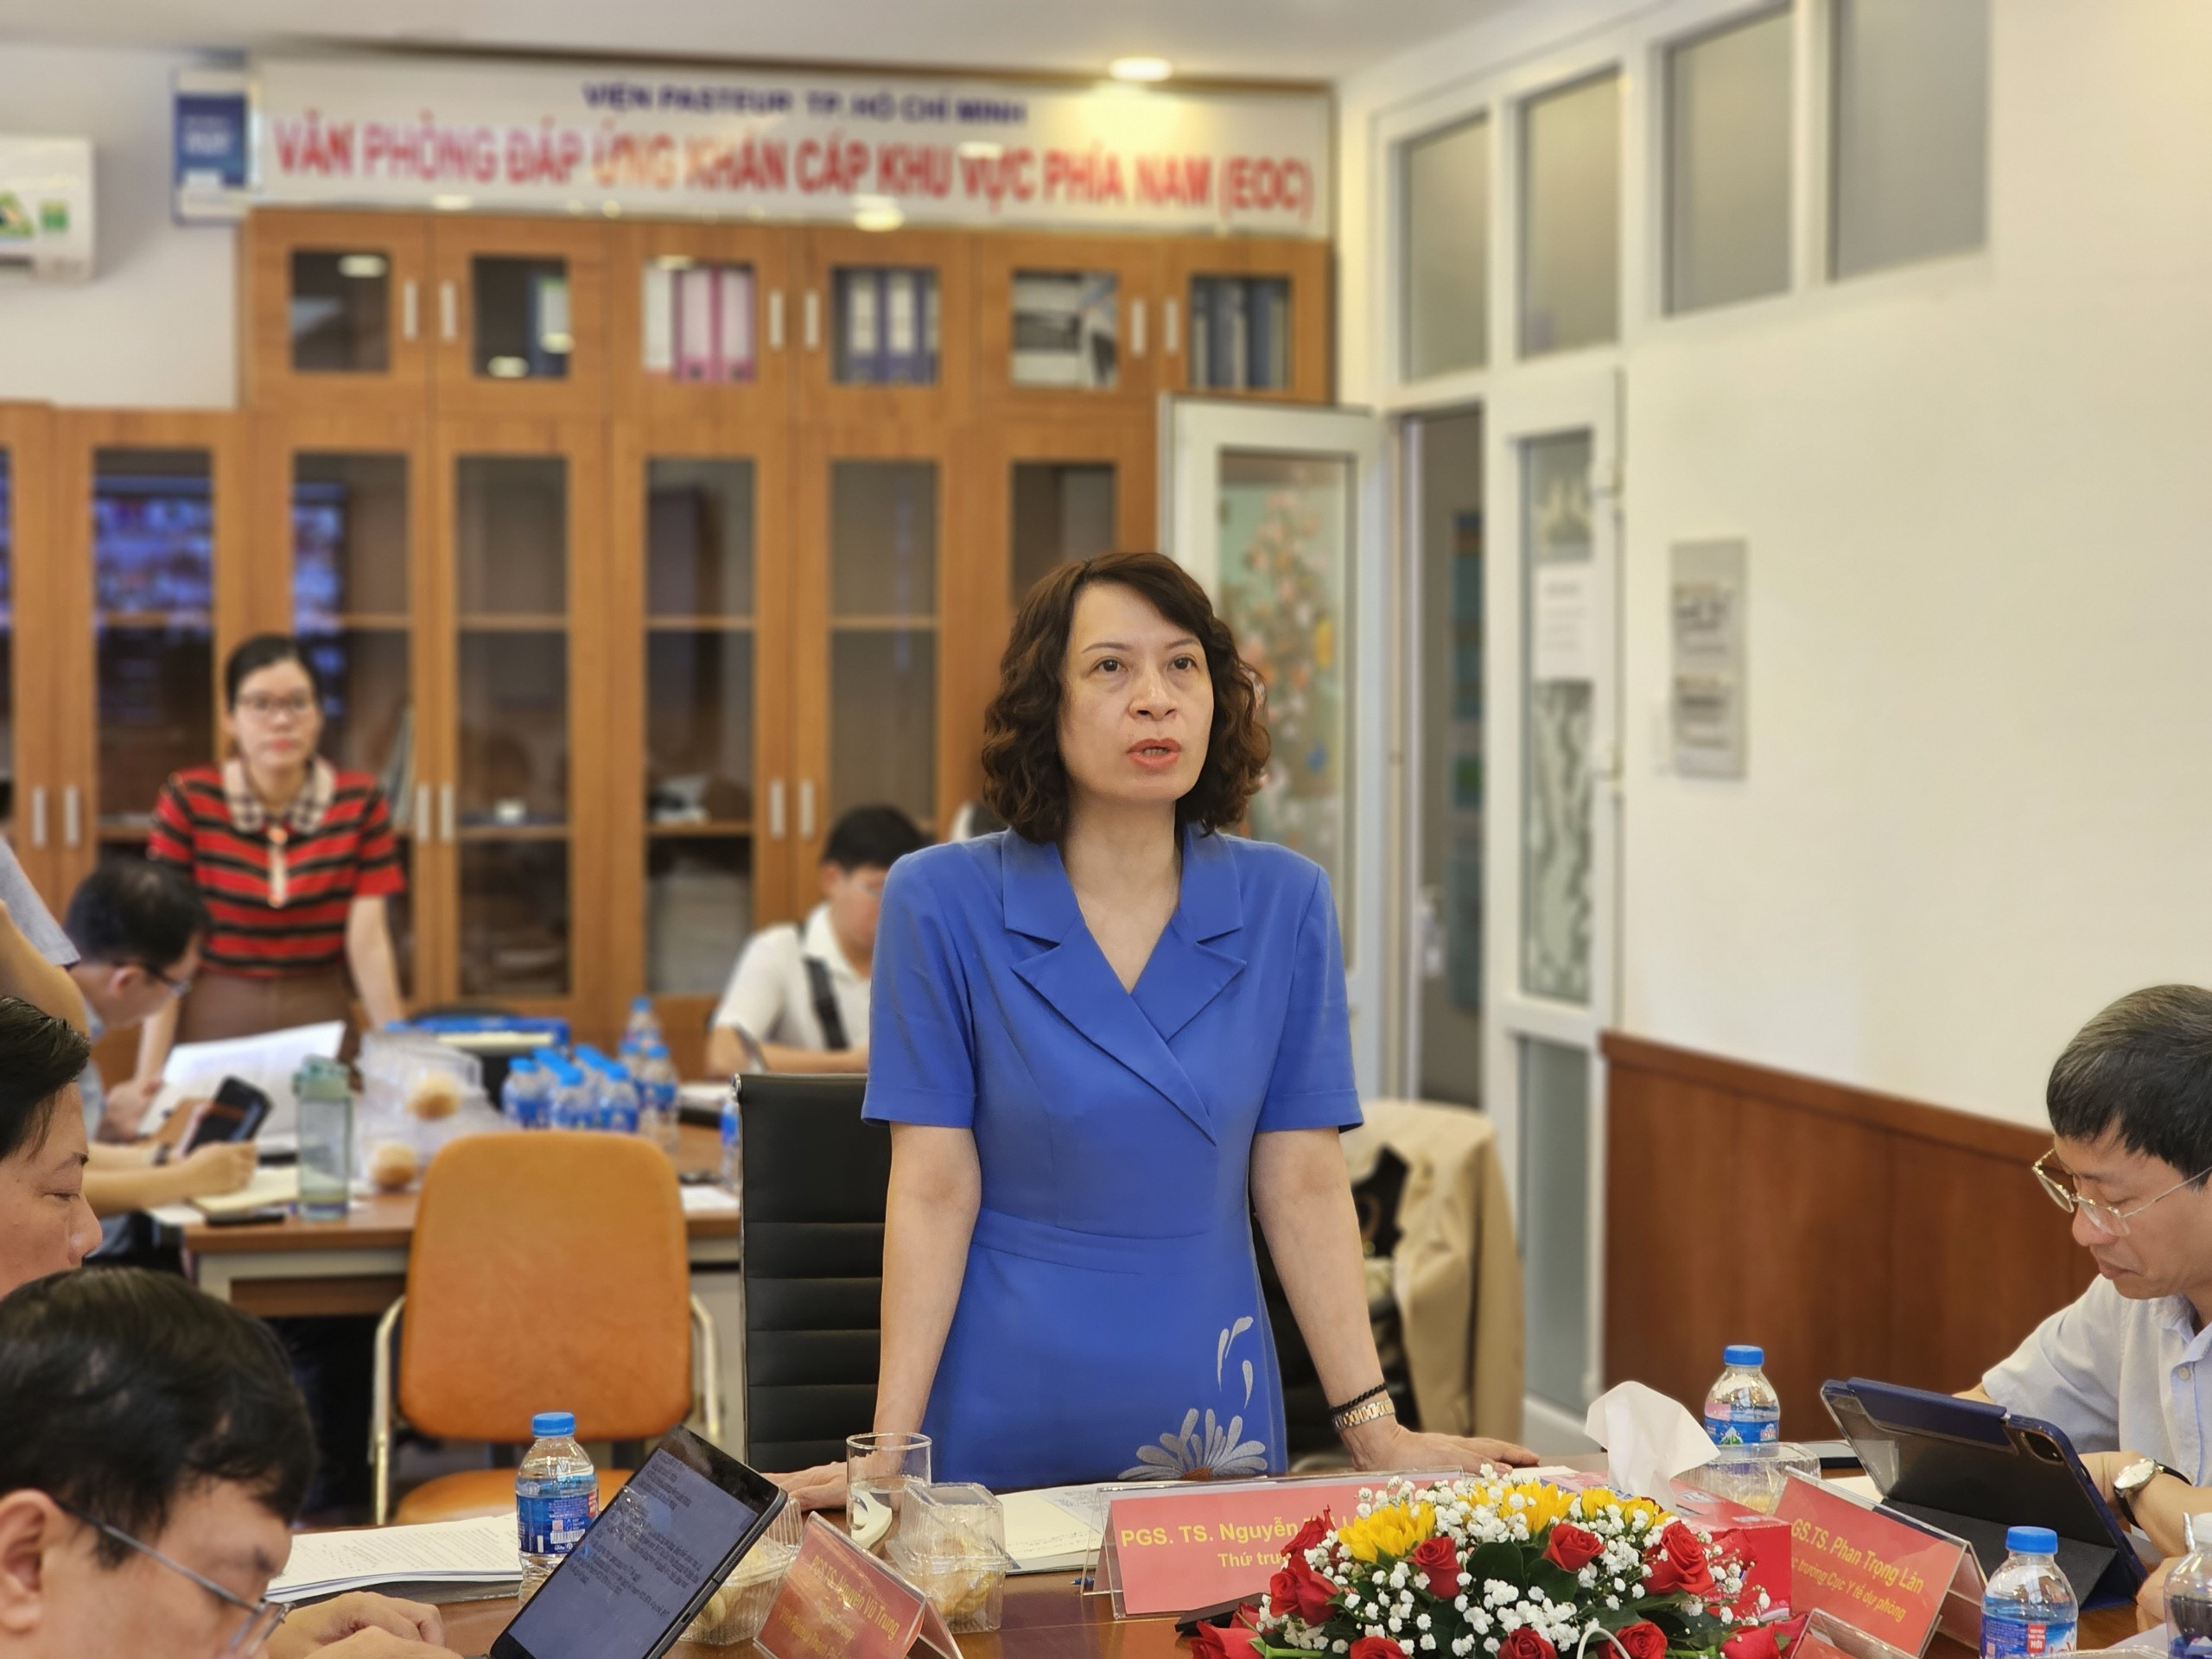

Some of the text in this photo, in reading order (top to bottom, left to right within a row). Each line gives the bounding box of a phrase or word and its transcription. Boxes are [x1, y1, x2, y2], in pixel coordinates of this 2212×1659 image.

[658, 85, 791, 114] PASTEUR
[955, 99, 1027, 124] MINH
[272, 107, 353, 177] VĂN
[362, 108, 499, 184] PHÒNG
[875, 142, 953, 200] KHU
[1134, 153, 1211, 207] NAM
[1217, 153, 1313, 221] (EOC)
[1121, 1528, 1173, 1547] PGS.
[1179, 1524, 1213, 1544] TS.
[1219, 1516, 1299, 1544] Nguyễn
[1217, 1552, 1252, 1567] Thứ
[1829, 1536, 1862, 1566] Phan
[1863, 1550, 1900, 1587] Trọng
[1846, 1580, 1856, 1594] Y
